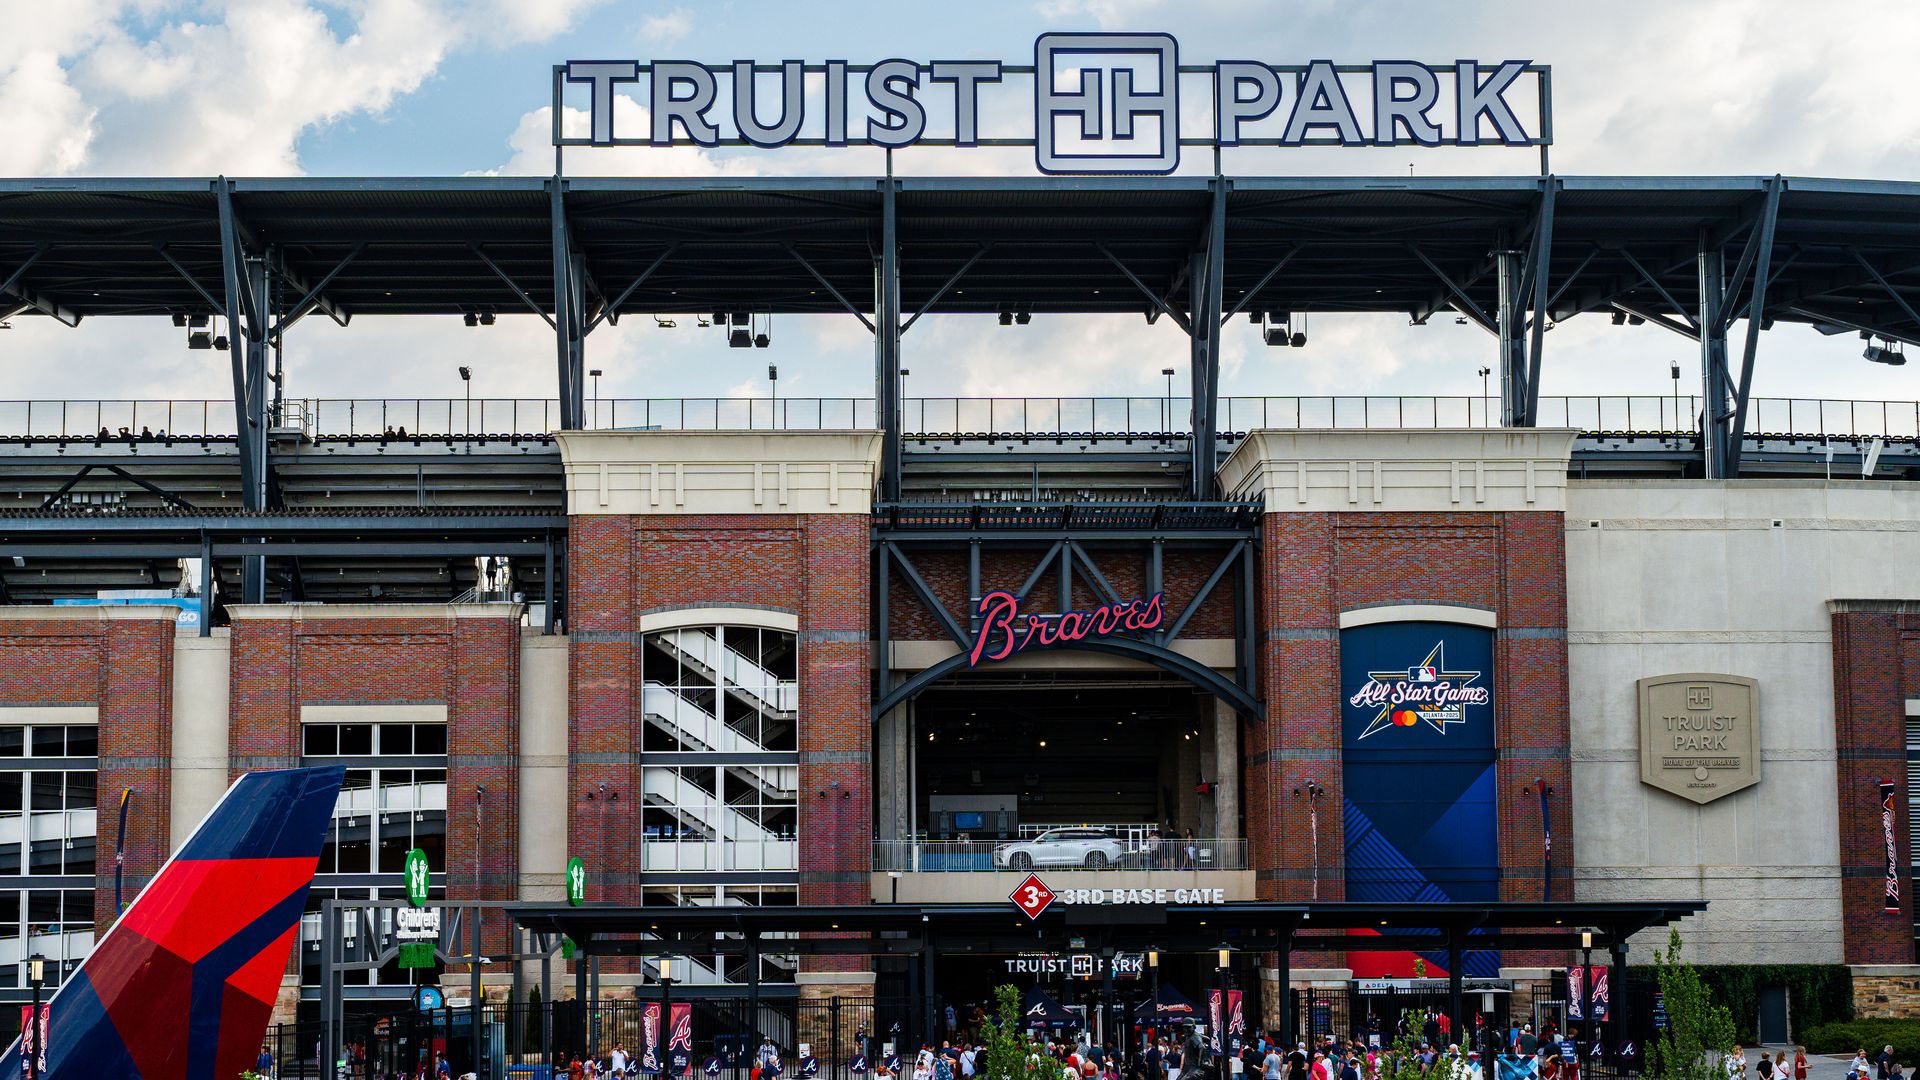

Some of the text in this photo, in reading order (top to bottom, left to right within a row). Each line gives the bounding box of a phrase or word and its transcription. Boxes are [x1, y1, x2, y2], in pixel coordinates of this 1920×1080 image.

[566, 59, 1534, 148] TRUIST PARK
[970, 590, 1163, 670] Braves
[1350, 681, 1488, 706] All Star Game
[1662, 715, 1737, 731] TRUIST
[1673, 735, 1728, 750] PARK
[1663, 759, 1682, 767] HOME
[1685, 759, 1694, 767] OF
[1882, 811, 1899, 901] Braves
[1063, 888, 1225, 905] 3RD BASE GATE
[1004, 959, 1067, 973] TRUIST
[1592, 974, 1608, 1003] A
[1026, 1002, 1047, 1016] A
[1229, 1001, 1243, 1035] A
[669, 1014, 692, 1051] A
[643, 1016, 659, 1070] Braves
[1590, 1042, 1602, 1056] A
[1621, 1042, 1635, 1056] A
[625, 1059, 637, 1073] A
[706, 1059, 719, 1073] A
[803, 1058, 816, 1072] A
[852, 1057, 866, 1071] A
